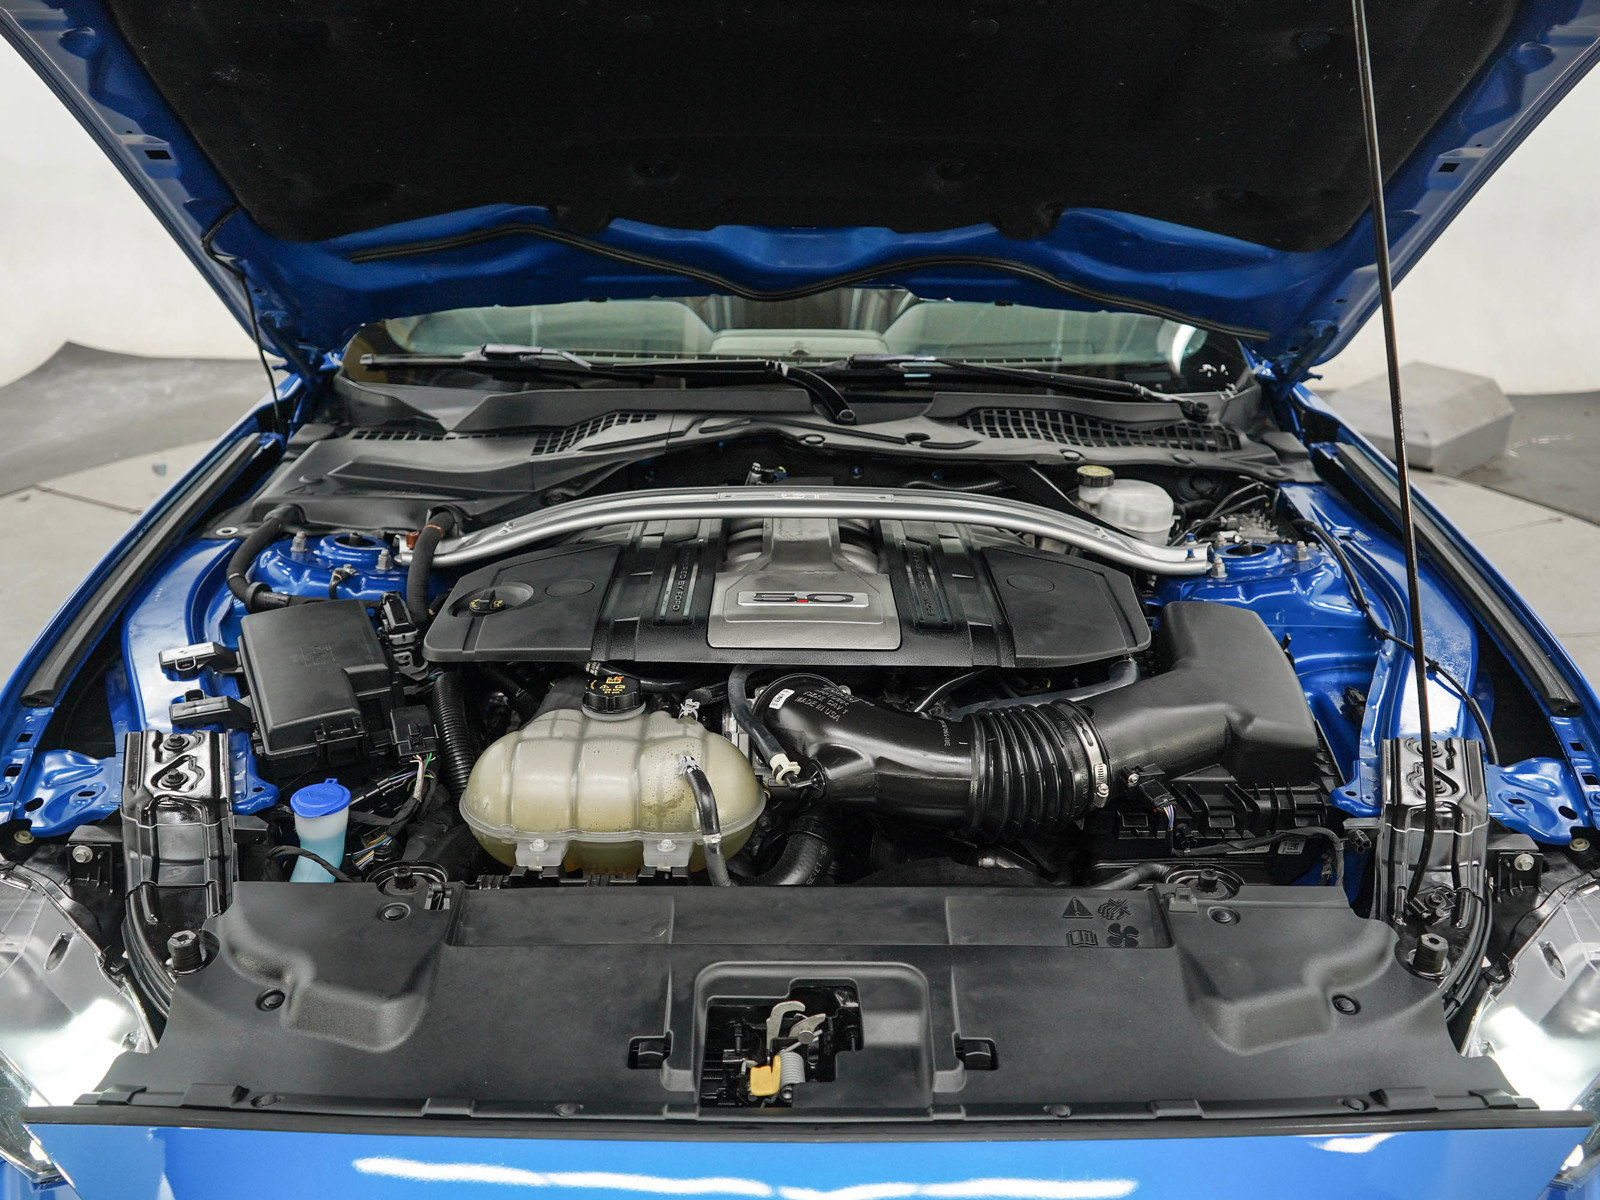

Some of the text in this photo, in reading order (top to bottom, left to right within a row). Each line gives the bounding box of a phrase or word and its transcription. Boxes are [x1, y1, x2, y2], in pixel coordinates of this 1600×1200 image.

[672, 551, 690, 611] WERED BY FORD
[752, 592, 855, 603] 5.0
[796, 697, 818, 707] MADE
[824, 708, 841, 722] USA
